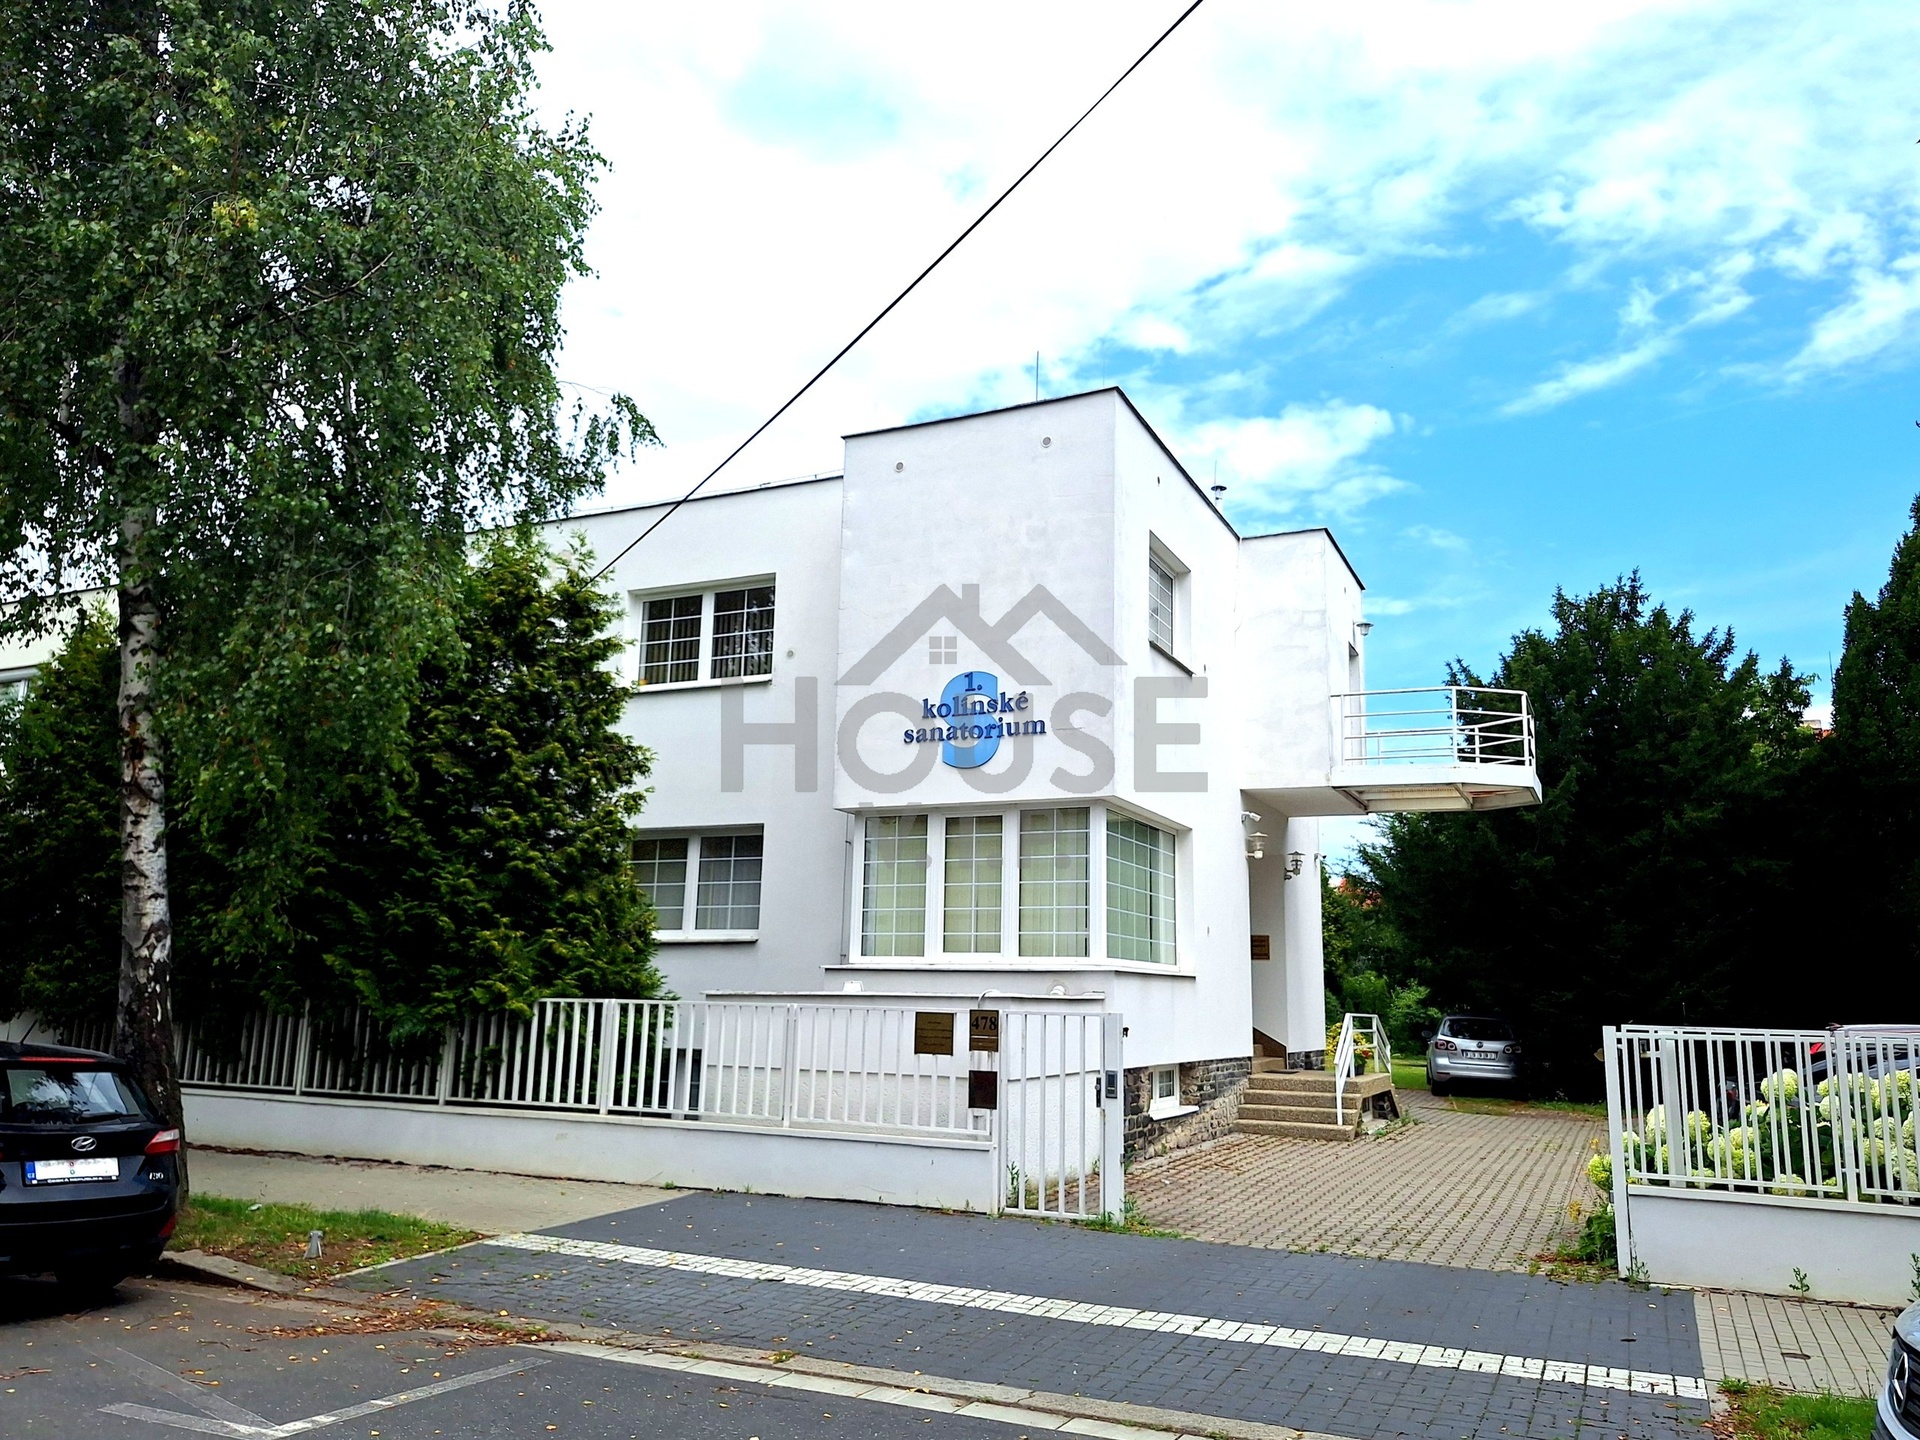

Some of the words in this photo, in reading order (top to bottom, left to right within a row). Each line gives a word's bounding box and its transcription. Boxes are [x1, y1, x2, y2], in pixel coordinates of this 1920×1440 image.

[964, 671, 983, 692] 1.
[921, 690, 1029, 719] kolínské
[903, 716, 1047, 744] sanatorium
[971, 1016, 997, 1031] 478
